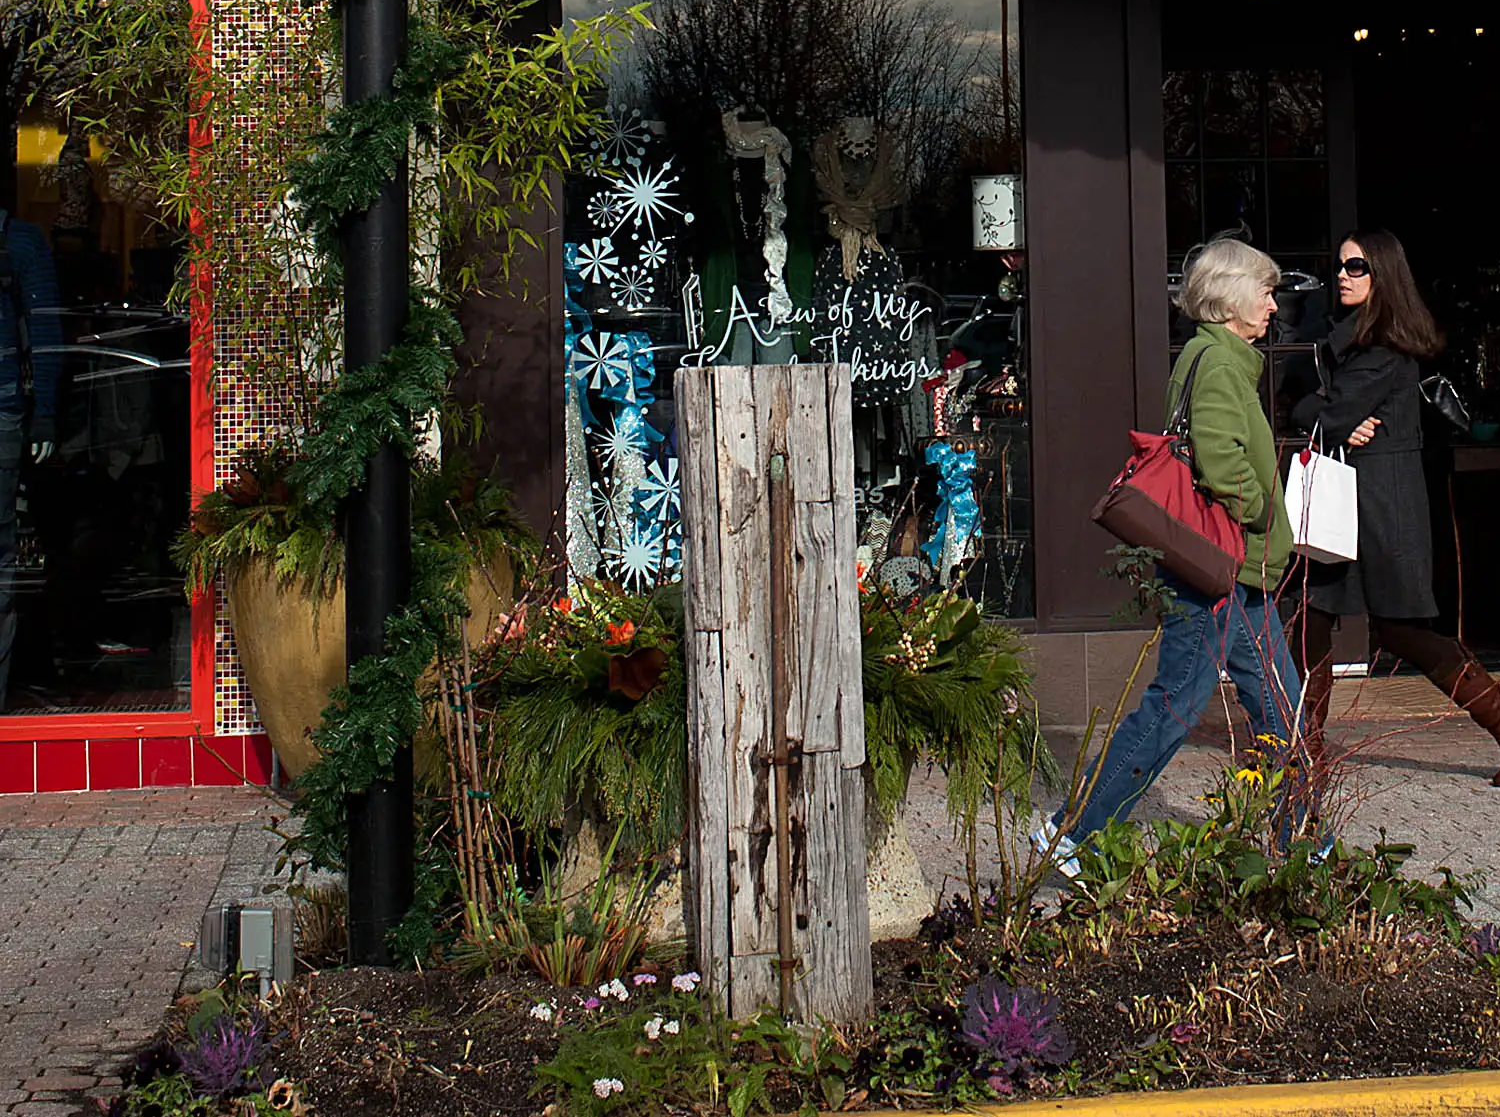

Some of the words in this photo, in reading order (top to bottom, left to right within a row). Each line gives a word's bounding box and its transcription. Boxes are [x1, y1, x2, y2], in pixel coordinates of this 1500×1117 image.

[707, 284, 781, 362] A
[827, 286, 854, 329] of
[862, 290, 932, 342] My
